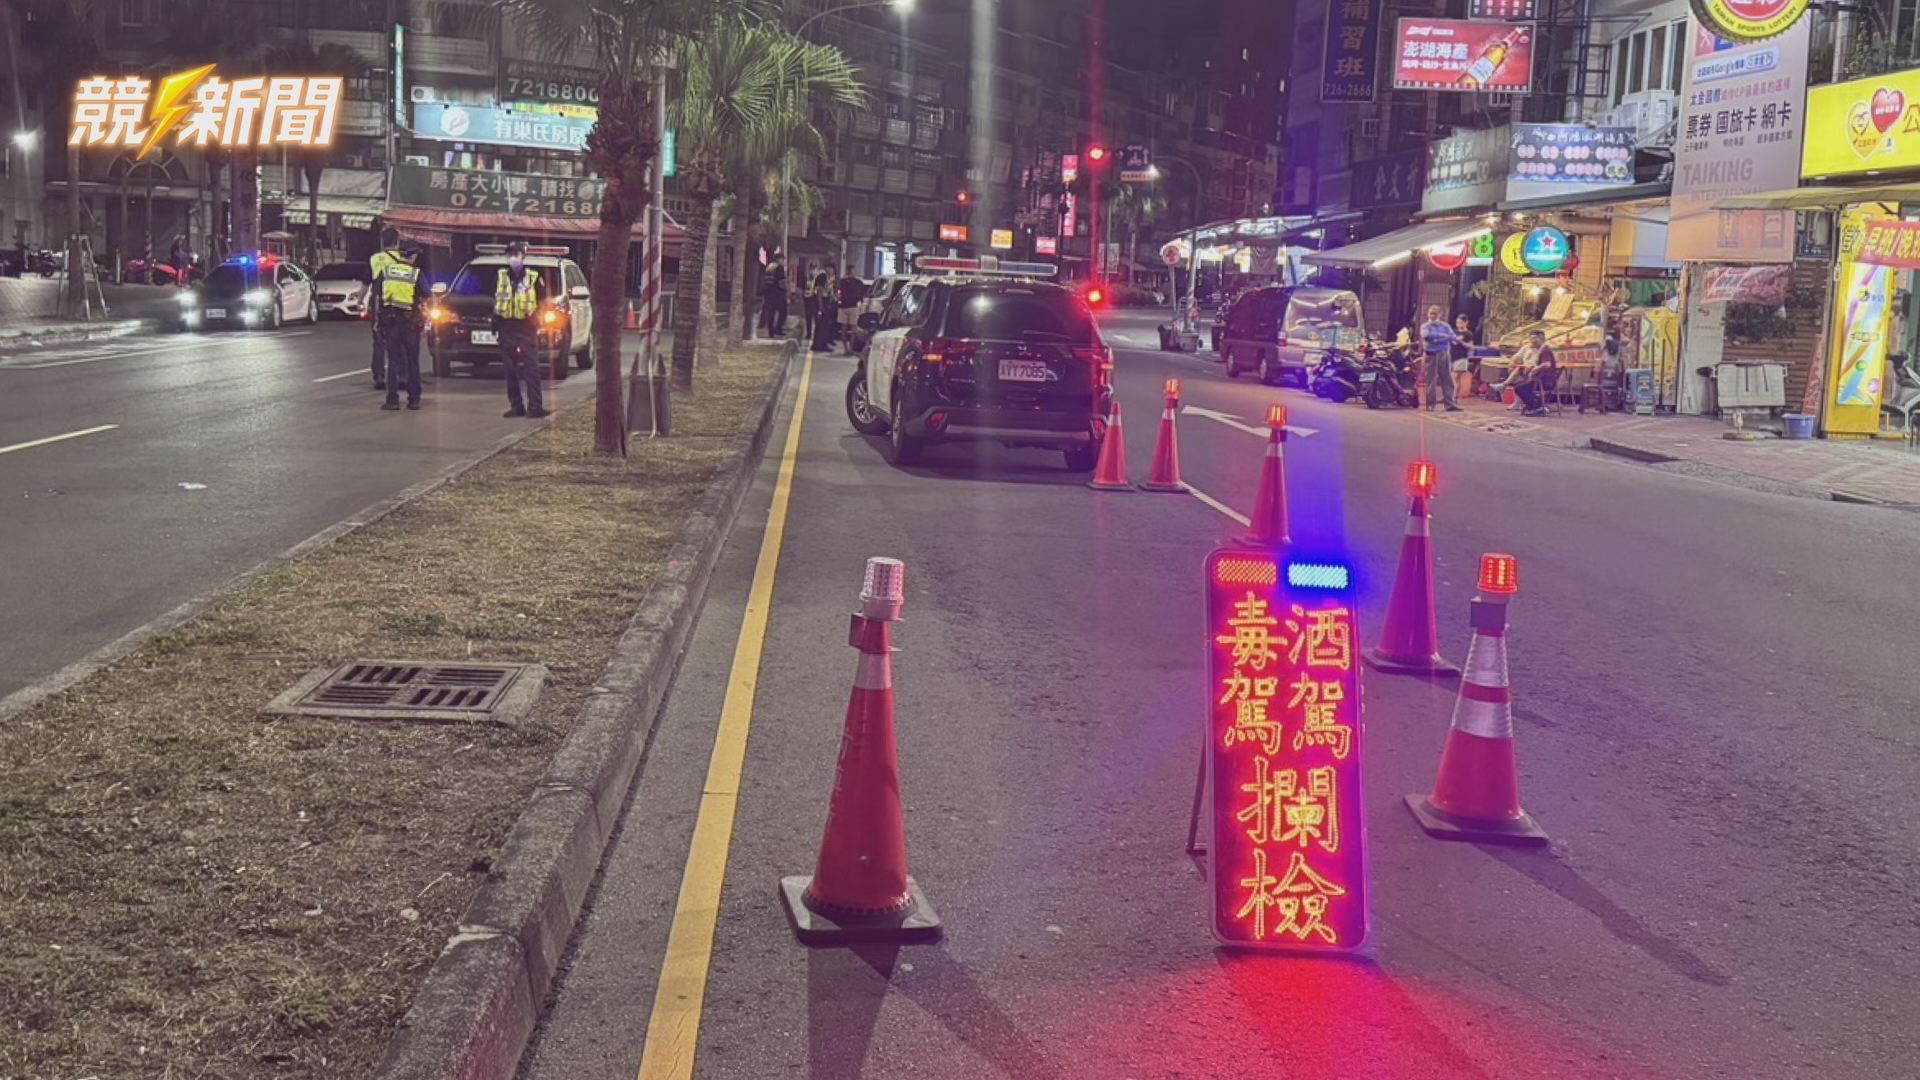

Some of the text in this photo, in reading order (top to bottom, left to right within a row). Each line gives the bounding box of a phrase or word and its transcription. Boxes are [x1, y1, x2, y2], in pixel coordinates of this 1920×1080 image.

[1712, 3, 1798, 32] TAIWAN SPORTS LOTTERY
[1403, 41, 1469, 60] 澎湖海產
[1685, 100, 1792, 140] 票券 國旅卡 網卡
[1682, 158, 1753, 186] TAIKING
[450, 193, 602, 215] 07-72168
